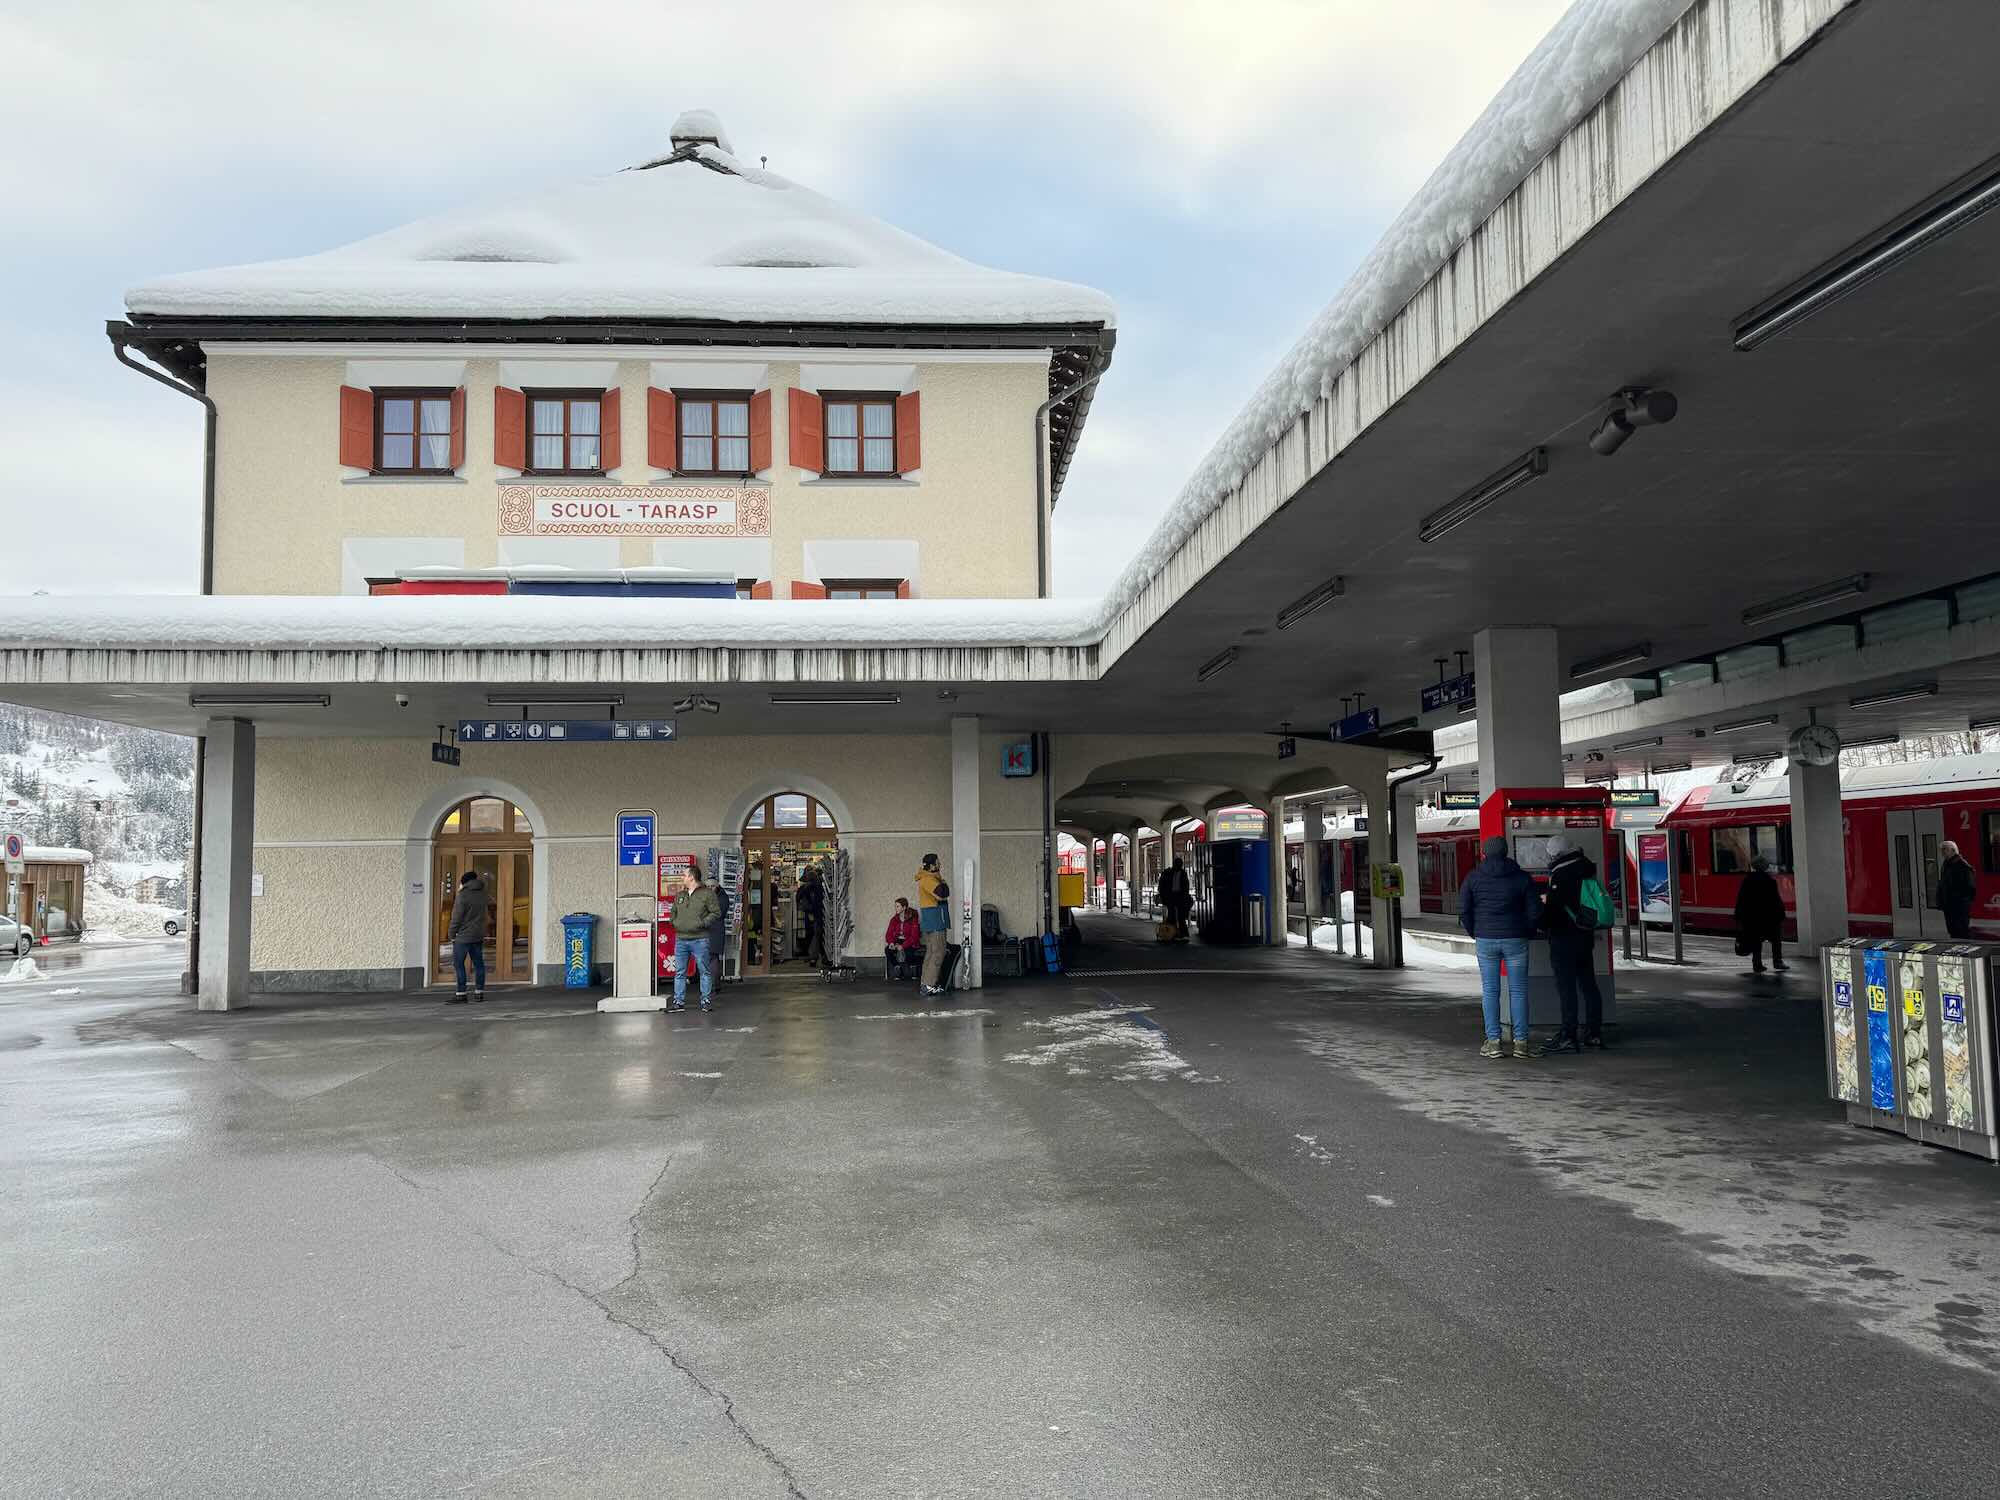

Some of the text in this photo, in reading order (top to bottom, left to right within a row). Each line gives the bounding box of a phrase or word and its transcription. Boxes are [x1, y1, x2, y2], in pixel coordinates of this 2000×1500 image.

[551, 503, 620, 518] SCUOL
[638, 504, 718, 519] TARASP
[1008, 751, 1024, 769] K
[1960, 809, 1970, 829] 2
